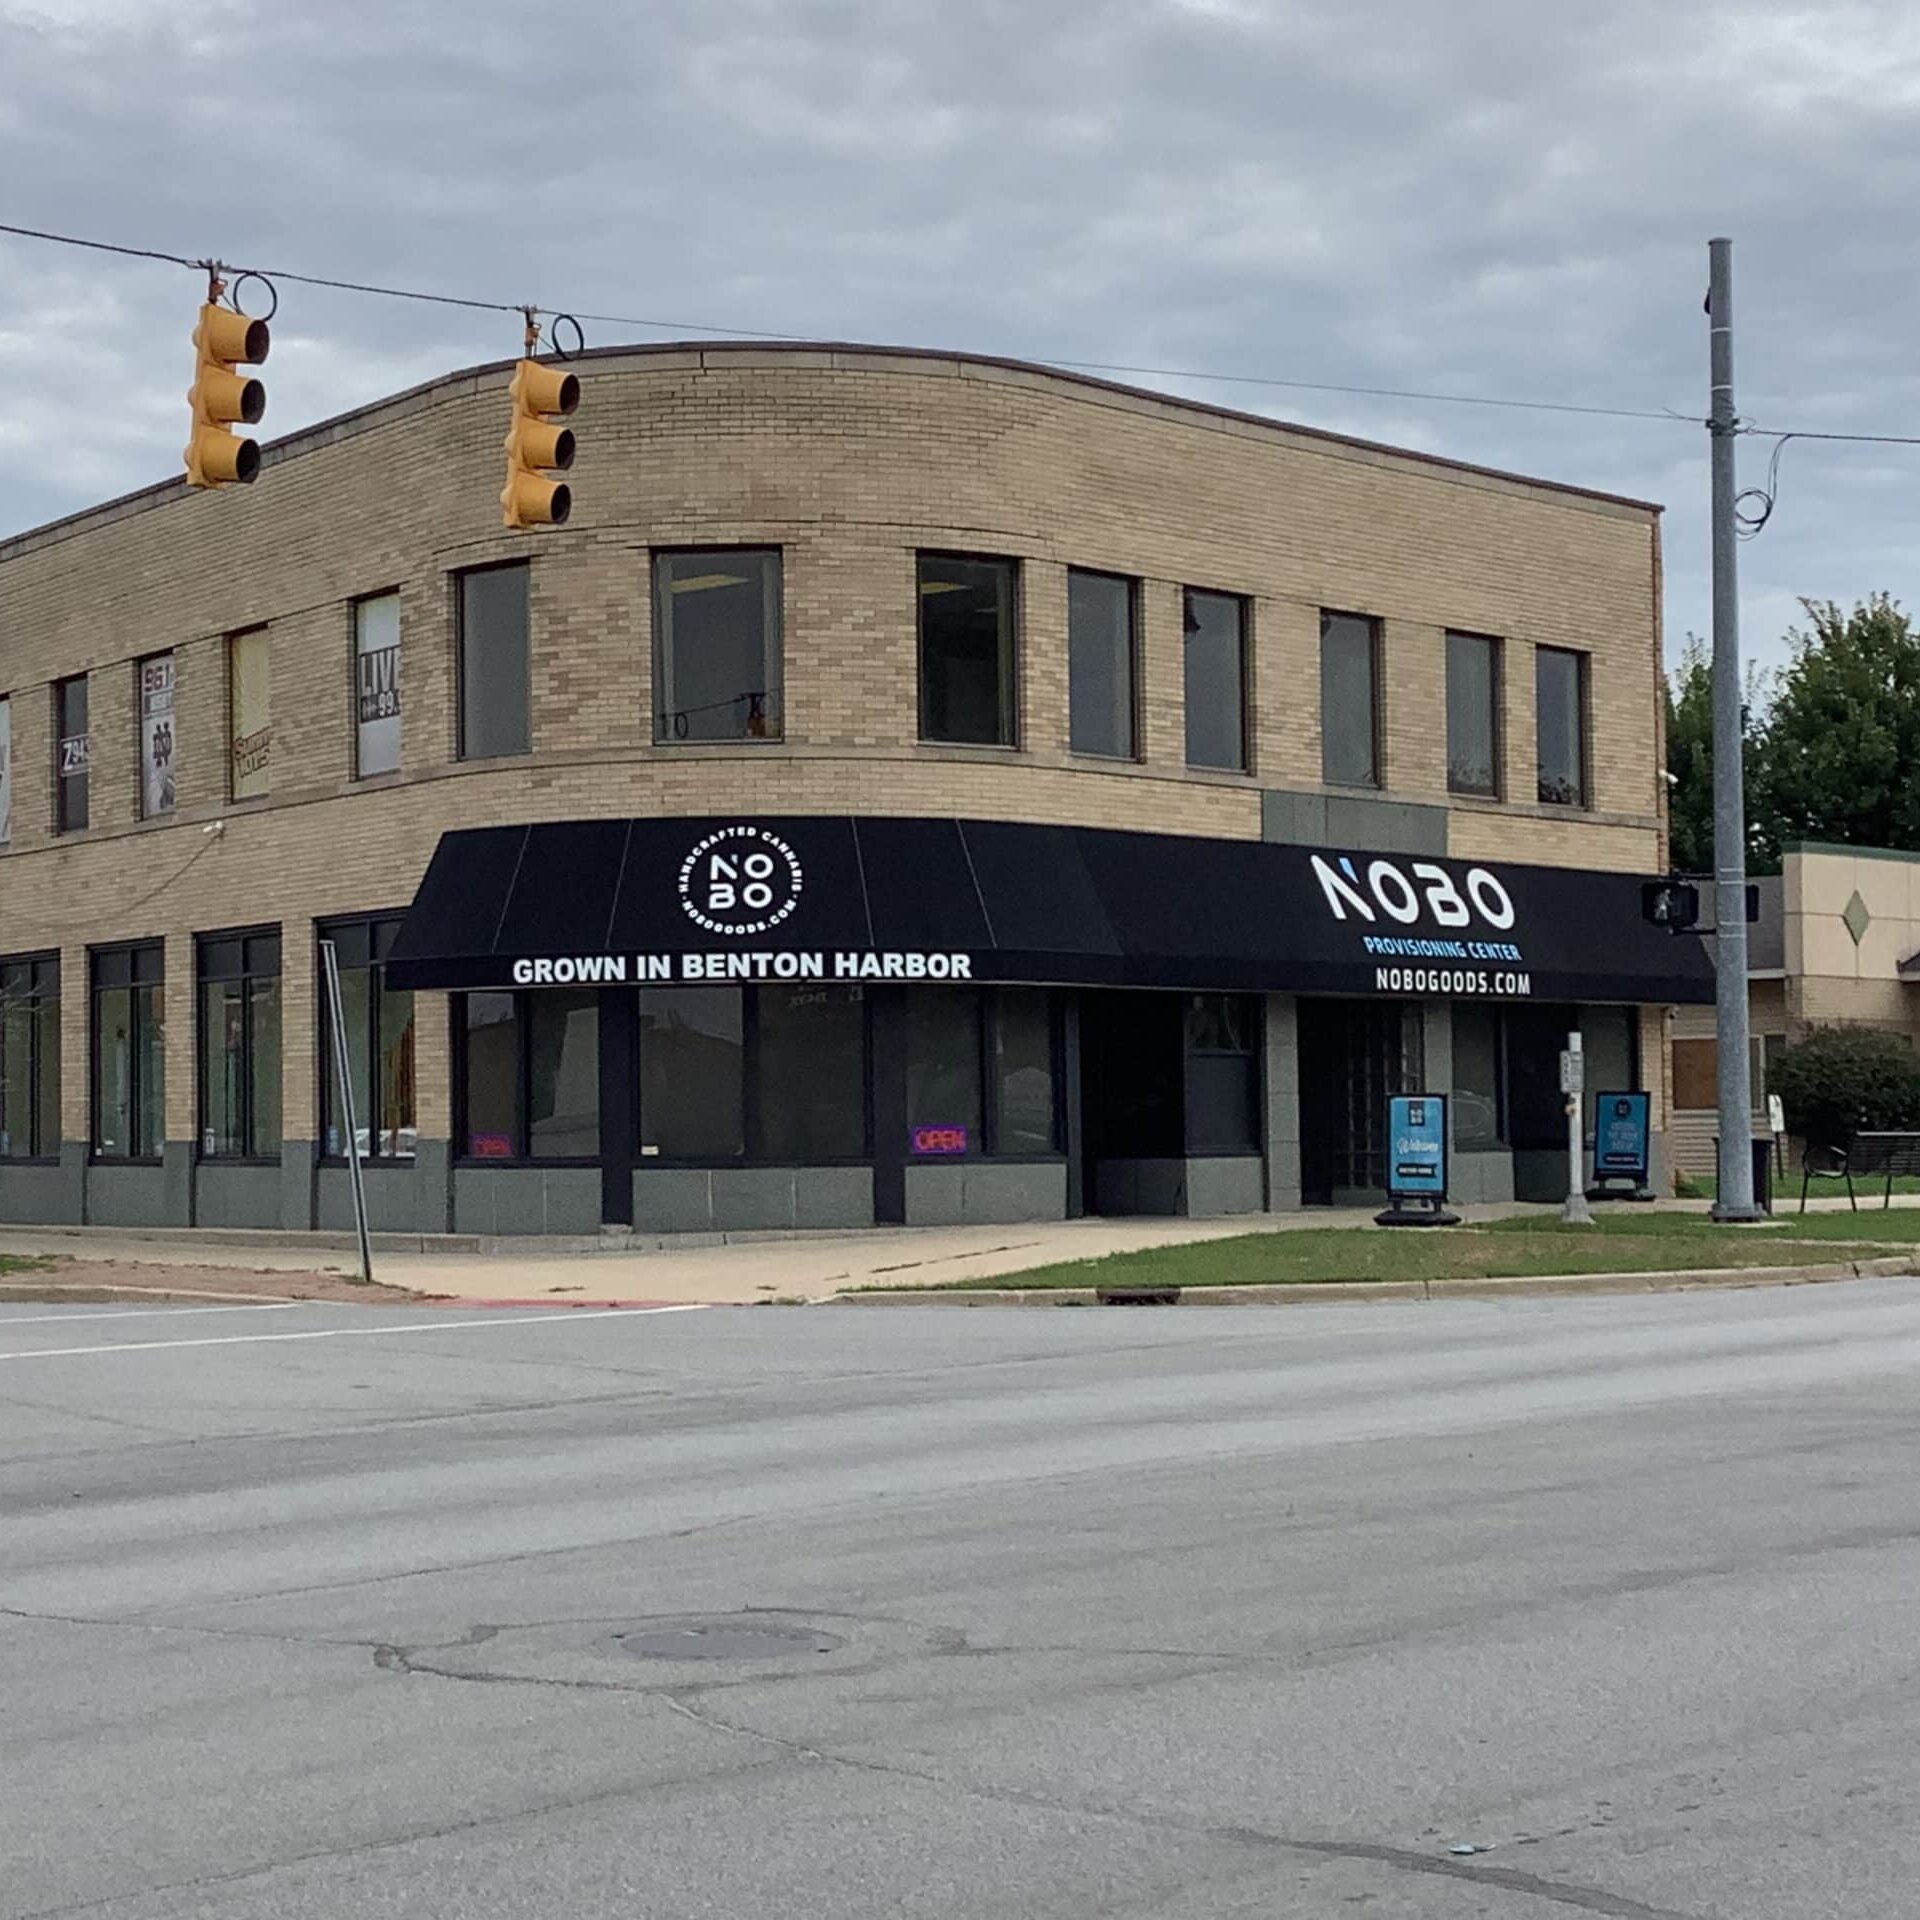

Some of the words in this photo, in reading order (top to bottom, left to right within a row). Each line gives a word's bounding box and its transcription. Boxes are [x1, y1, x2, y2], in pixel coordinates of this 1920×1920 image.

[761, 831, 803, 892] CANNABIS
[1310, 854, 1516, 930] NOBO
[1363, 936, 1466, 958] PROVISIONING
[1468, 942, 1523, 961] CENTER
[513, 956, 626, 984] GROWN
[637, 954, 671, 980] IN
[682, 952, 824, 979] BENTON
[835, 952, 972, 979] HARBOR
[1376, 967, 1531, 995] NOBOGOODS.COM
[915, 1130, 966, 1151] OPEN
